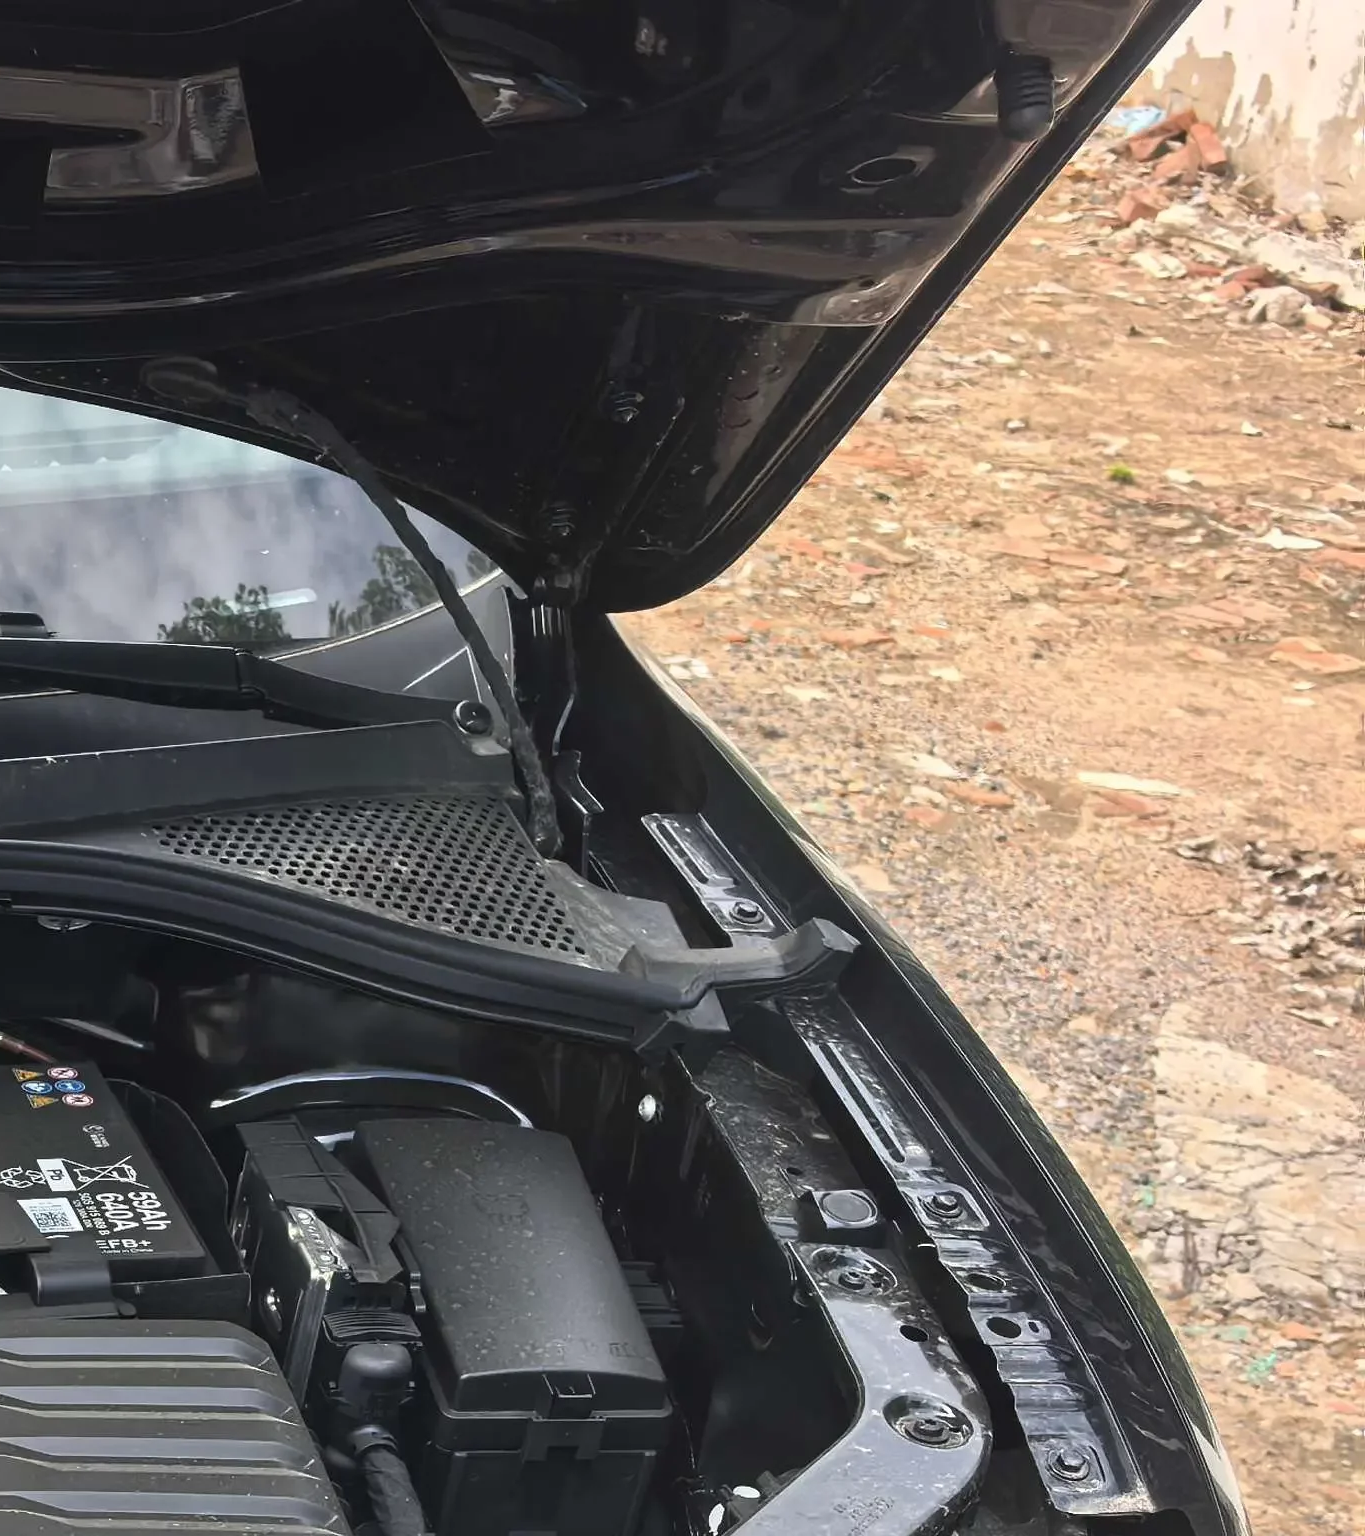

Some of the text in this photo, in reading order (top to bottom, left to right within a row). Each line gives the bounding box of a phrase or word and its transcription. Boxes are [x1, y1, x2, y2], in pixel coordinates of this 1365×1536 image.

[46, 1168, 65, 1181] Pb
[95, 1192, 140, 1232] 640A
[127, 1191, 172, 1231] 59Ah
[95, 1239, 152, 1250] EFB+
